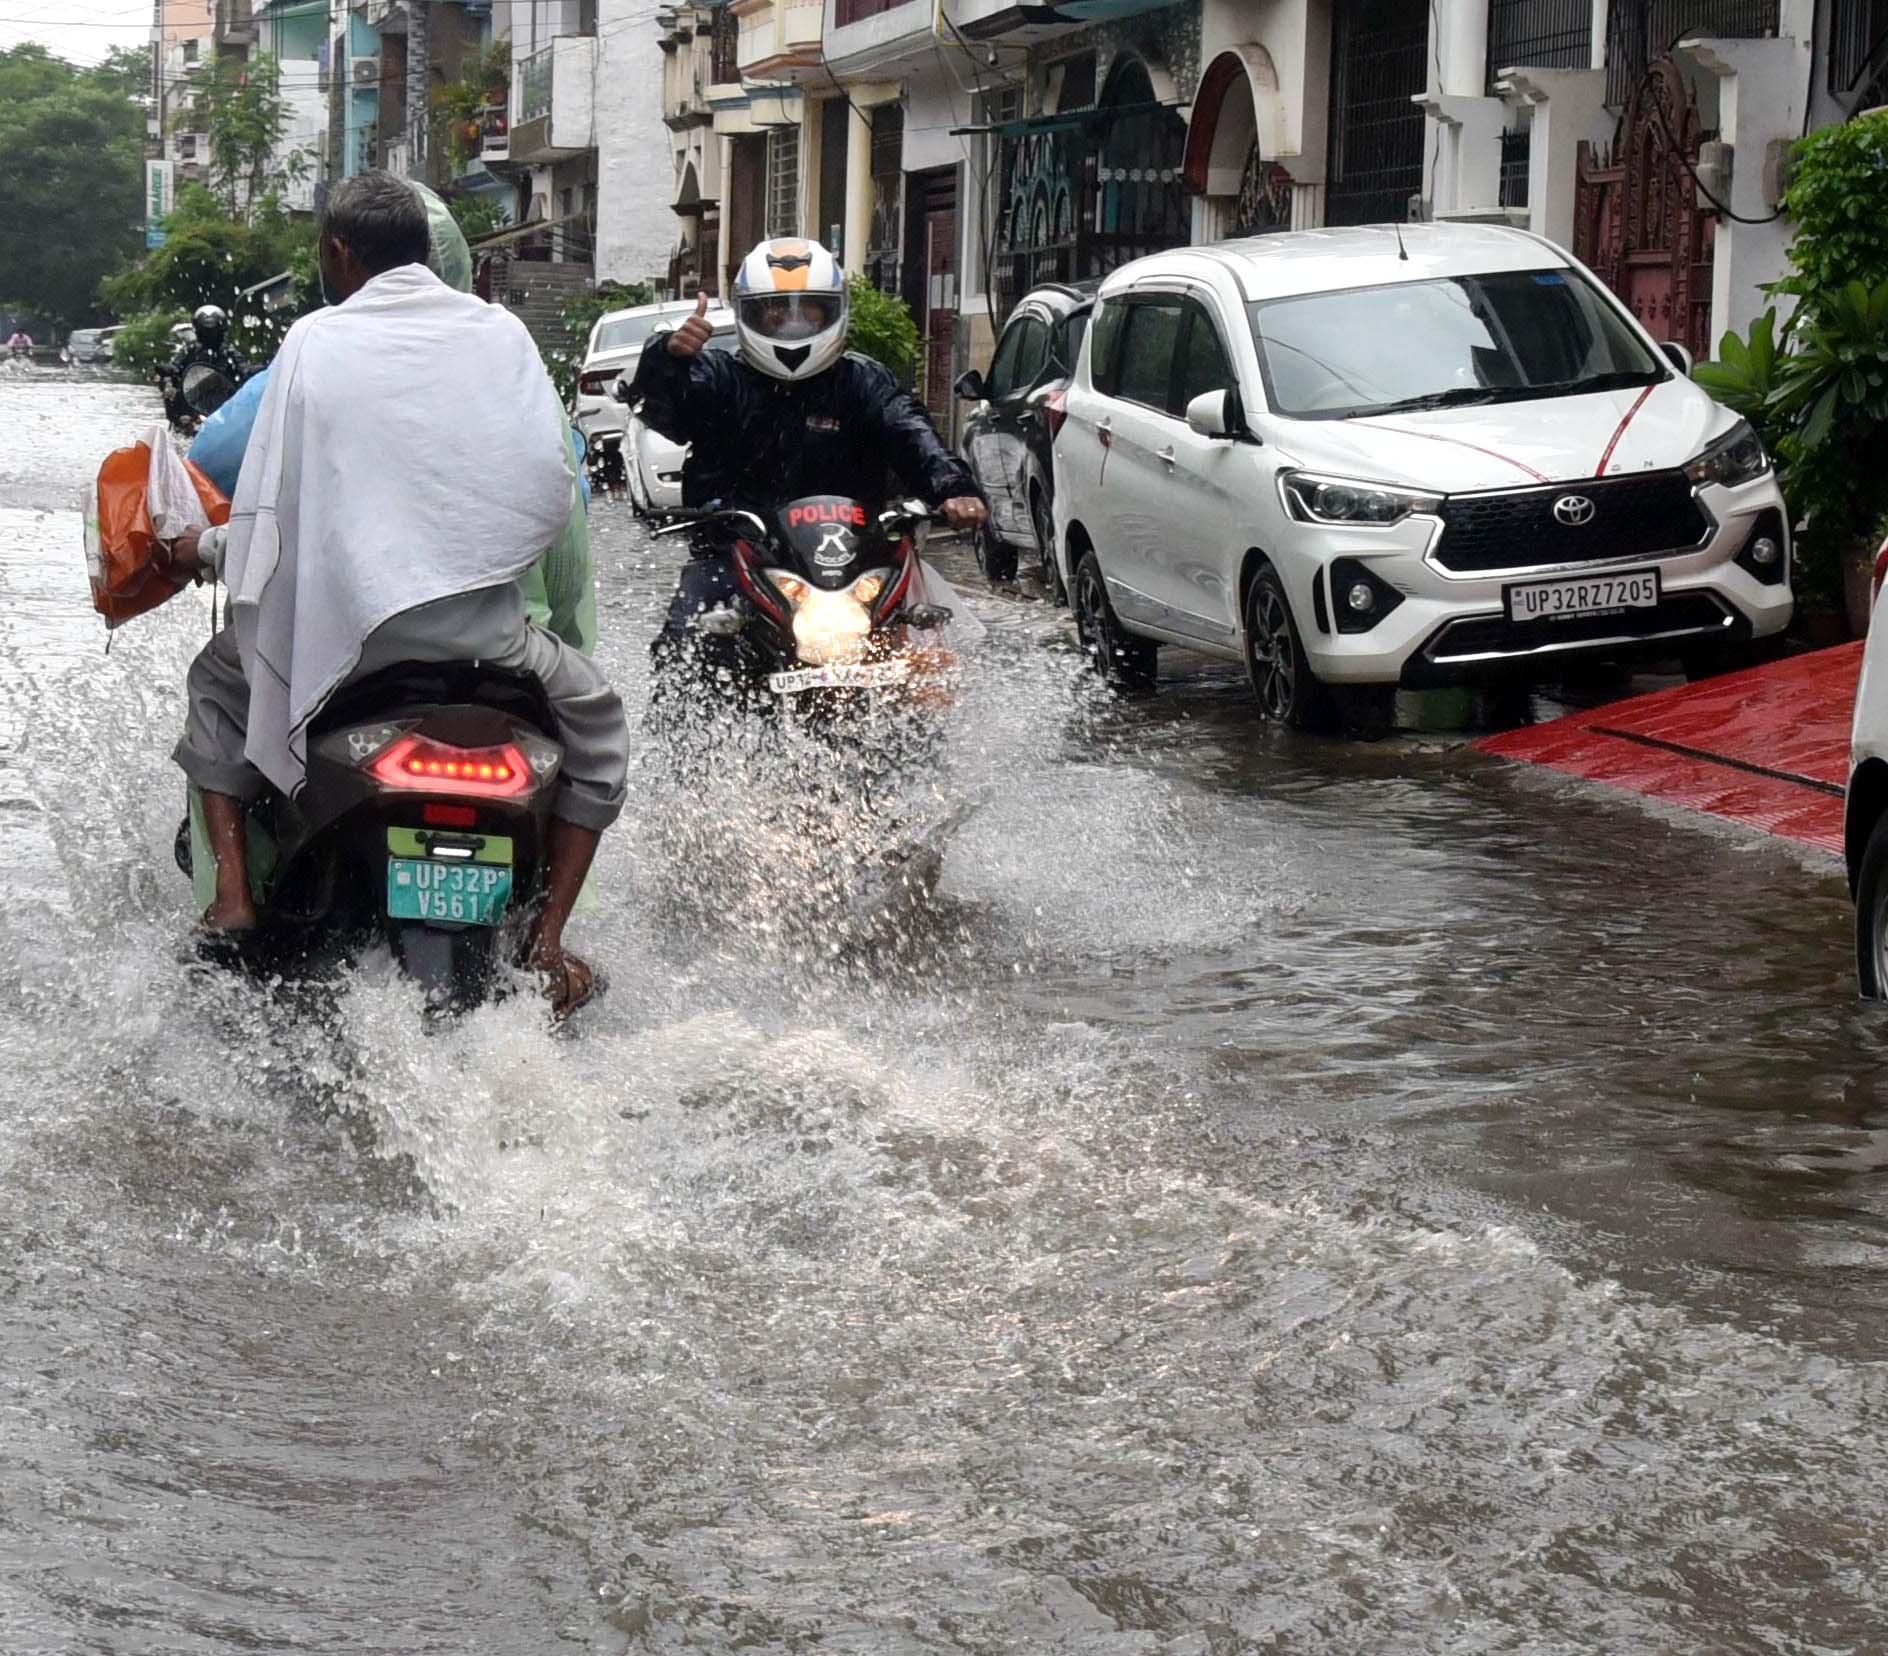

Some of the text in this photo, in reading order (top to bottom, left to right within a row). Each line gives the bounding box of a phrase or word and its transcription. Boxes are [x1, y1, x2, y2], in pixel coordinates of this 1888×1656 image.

[789, 503, 866, 528] POLICE
[1525, 578, 1654, 613] UP32RZ7205
[416, 863, 498, 894] UP32P
